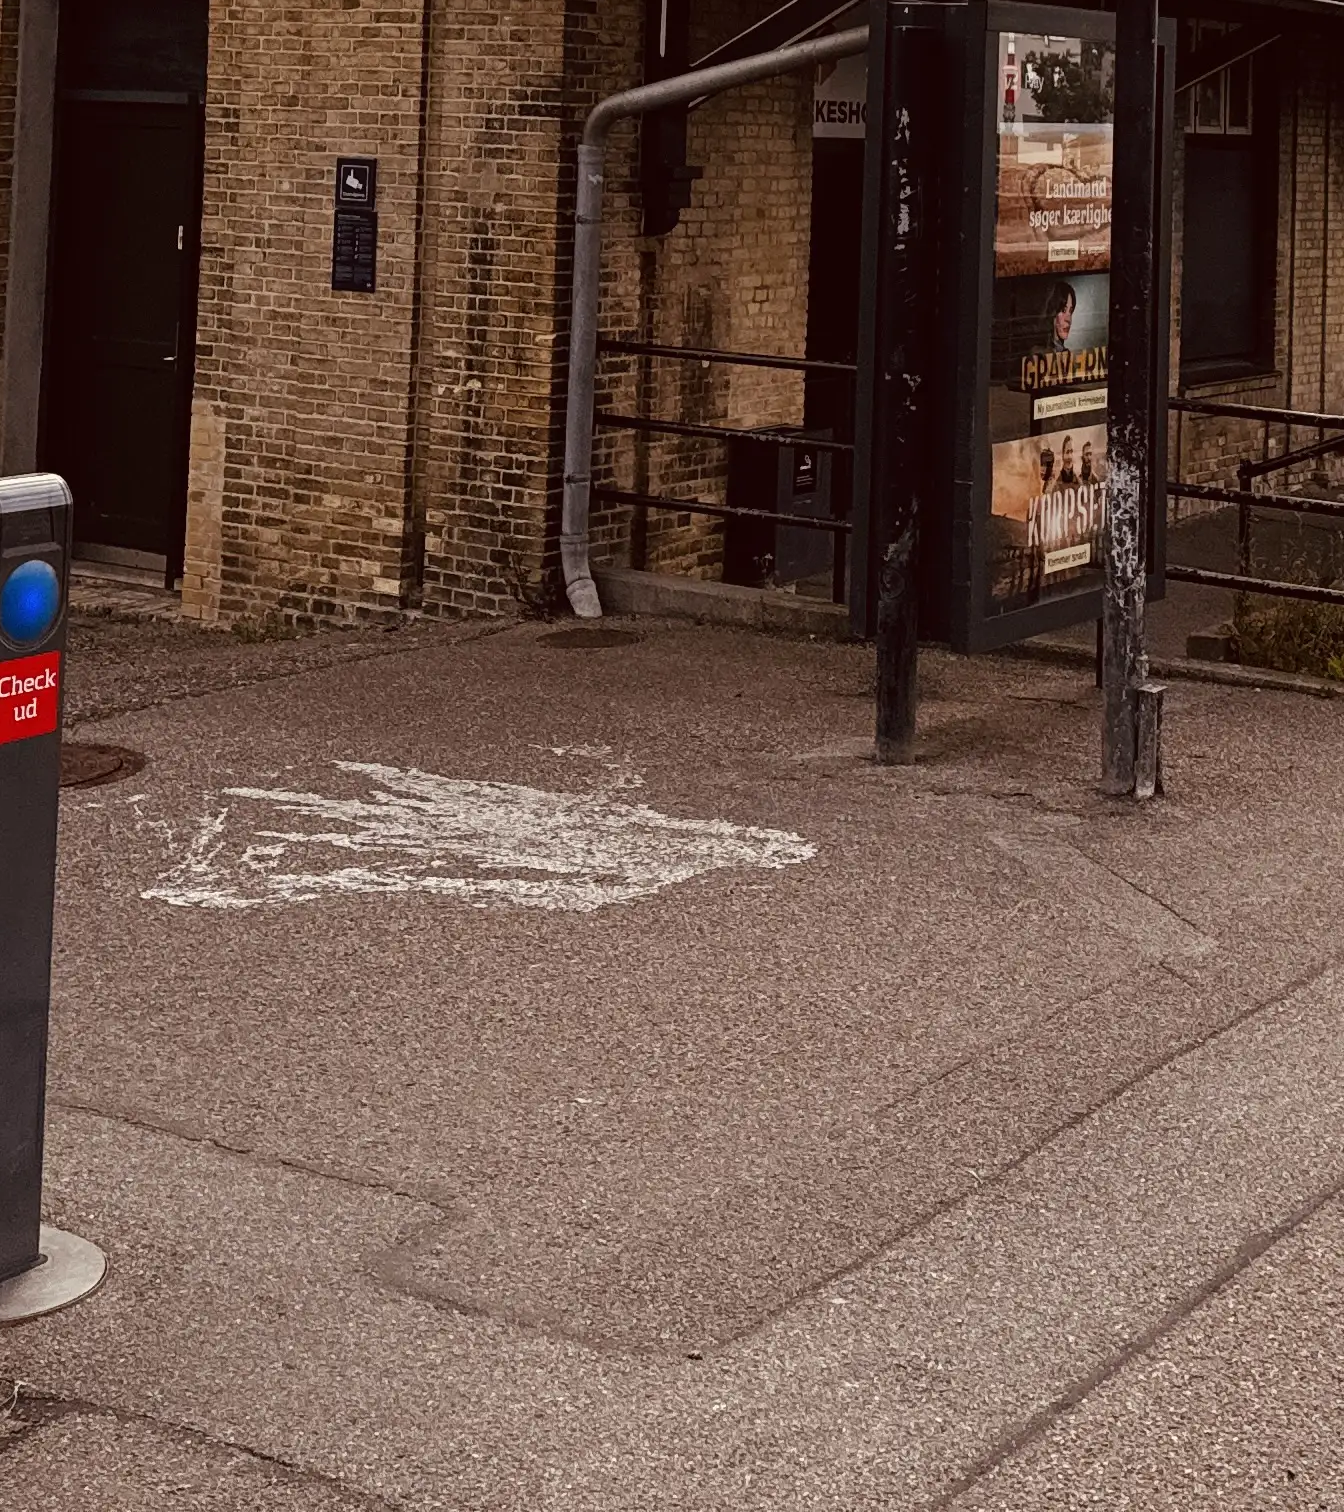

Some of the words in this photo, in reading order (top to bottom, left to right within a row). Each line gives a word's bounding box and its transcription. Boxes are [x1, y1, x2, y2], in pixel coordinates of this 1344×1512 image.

[1045, 177, 1107, 199] Landmand
[1029, 210, 1061, 232] søger
[14, 697, 37, 722] ud
